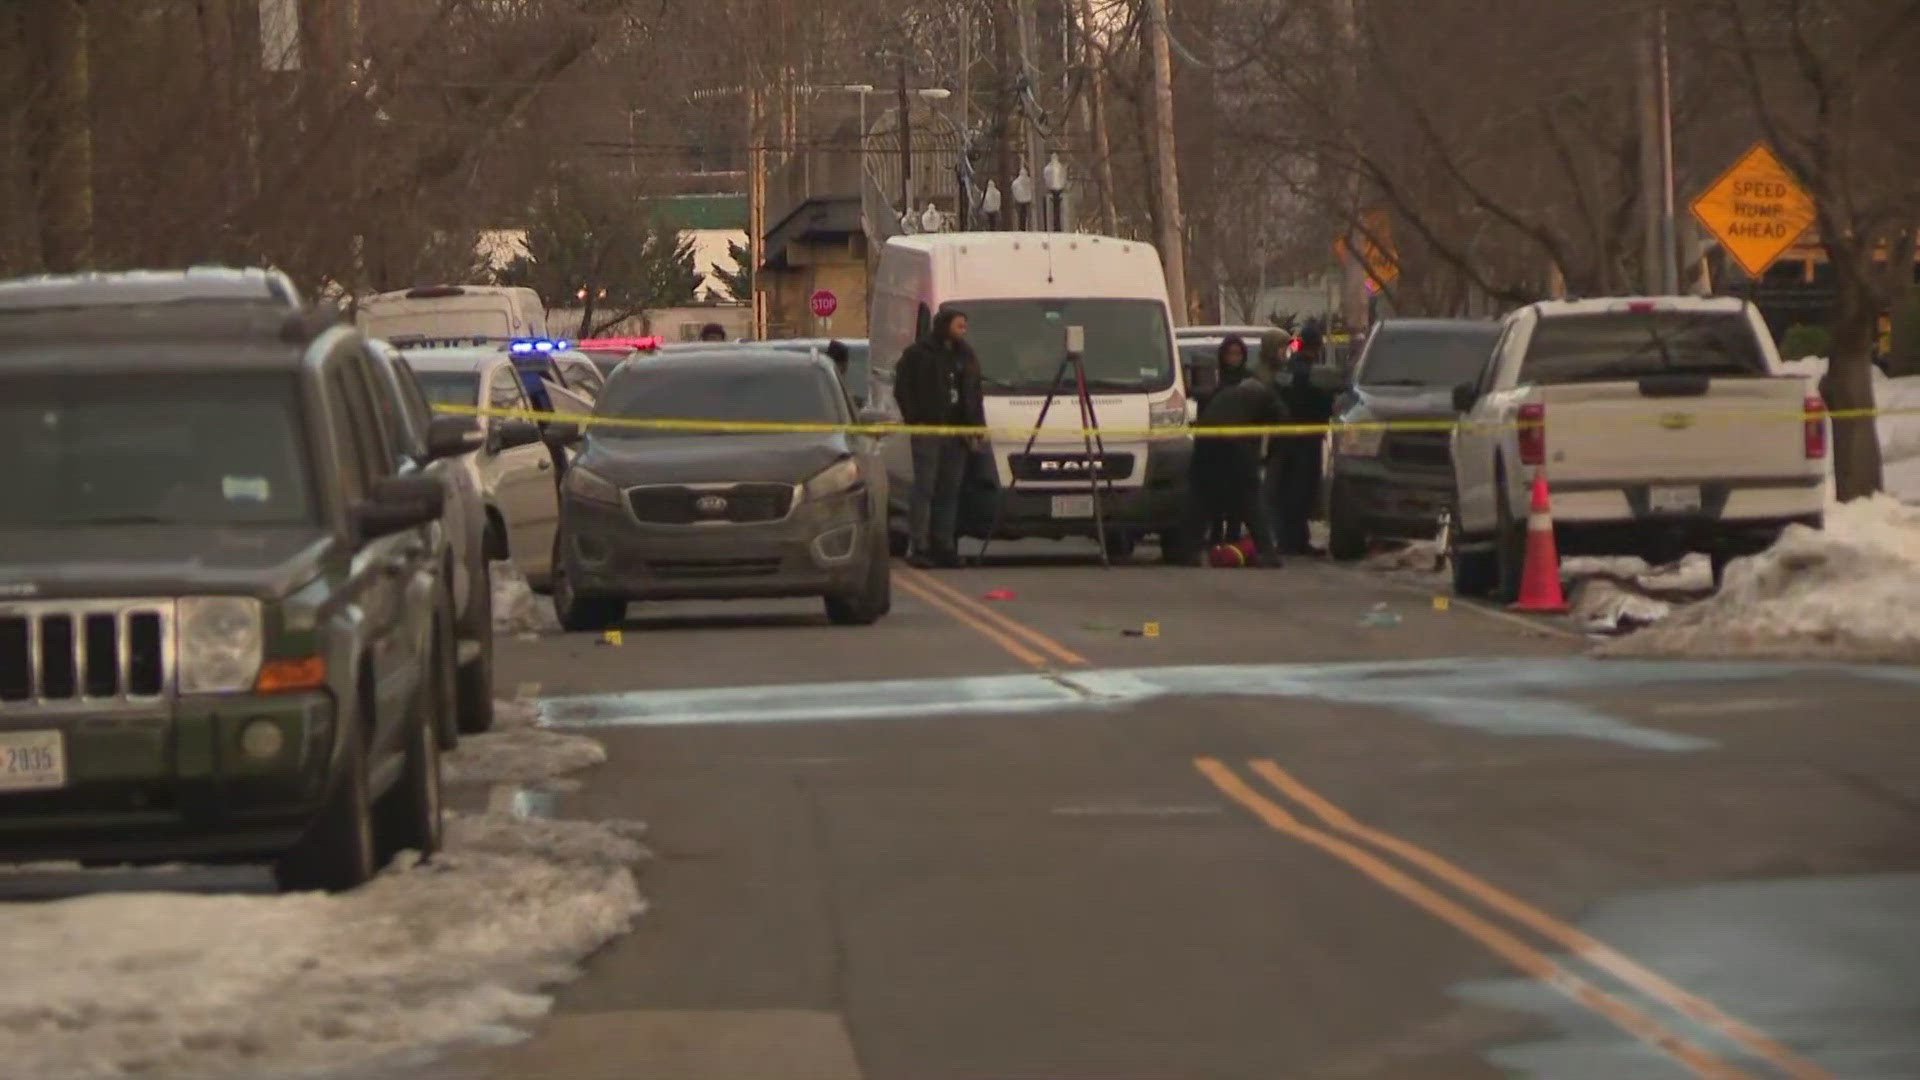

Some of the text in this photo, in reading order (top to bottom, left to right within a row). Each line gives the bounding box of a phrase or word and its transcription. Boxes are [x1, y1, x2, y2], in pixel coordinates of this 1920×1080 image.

[1733, 181, 1787, 198] SPEED
[1733, 202, 1784, 218] HUMP
[1728, 222, 1787, 238] AHEAD
[812, 298, 836, 310] STOP
[1041, 460, 1103, 471] RAM
